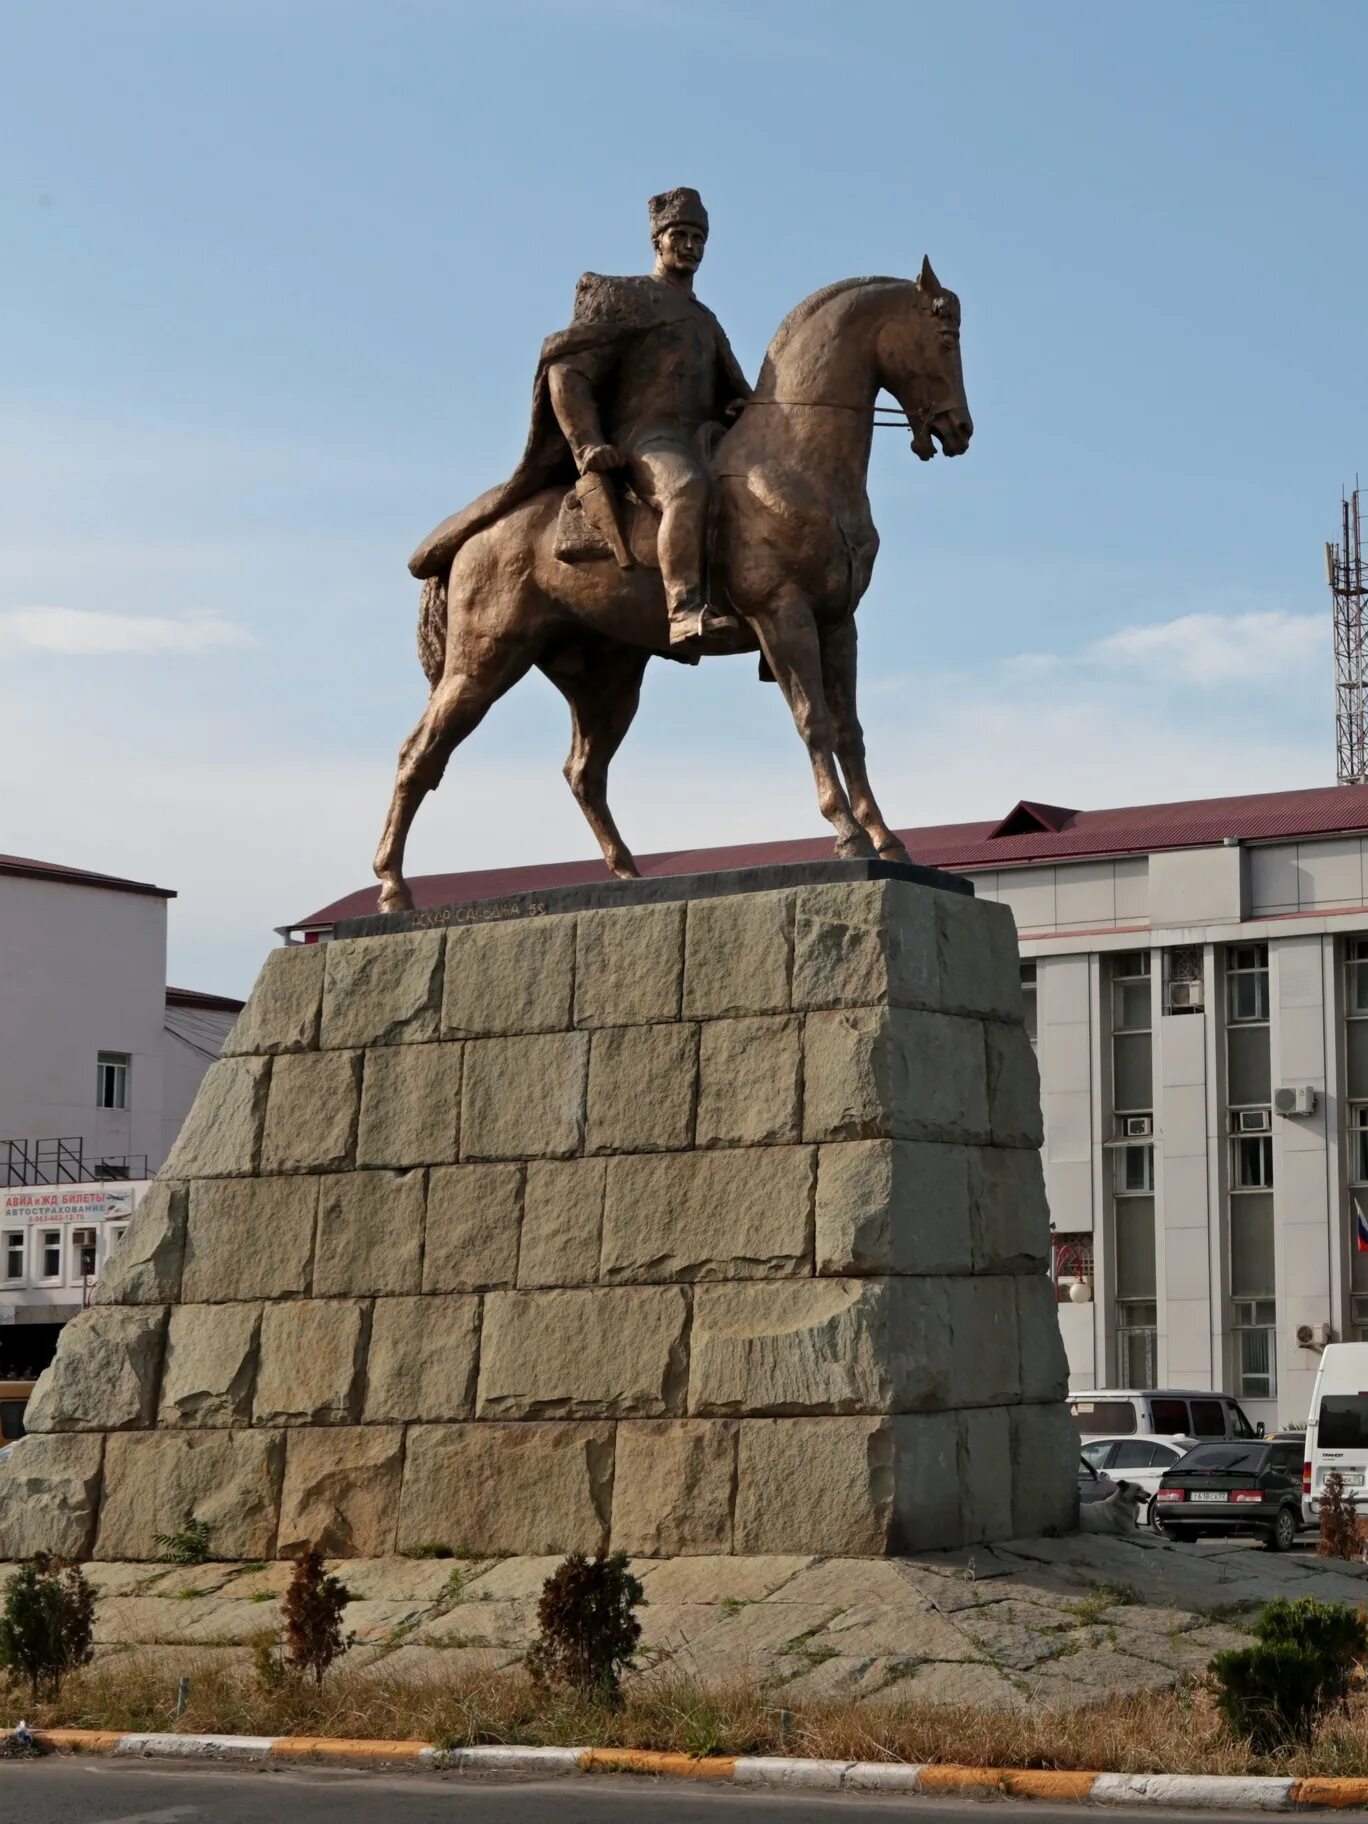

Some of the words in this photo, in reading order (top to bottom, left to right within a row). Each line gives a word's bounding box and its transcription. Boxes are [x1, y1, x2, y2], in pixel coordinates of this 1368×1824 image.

[5, 1196, 33, 1207] АВИА
[62, 1193, 106, 1204] БИЛЕТЫ
[5, 1204, 105, 1217] АВТОСТРАХОВАНИЕ
